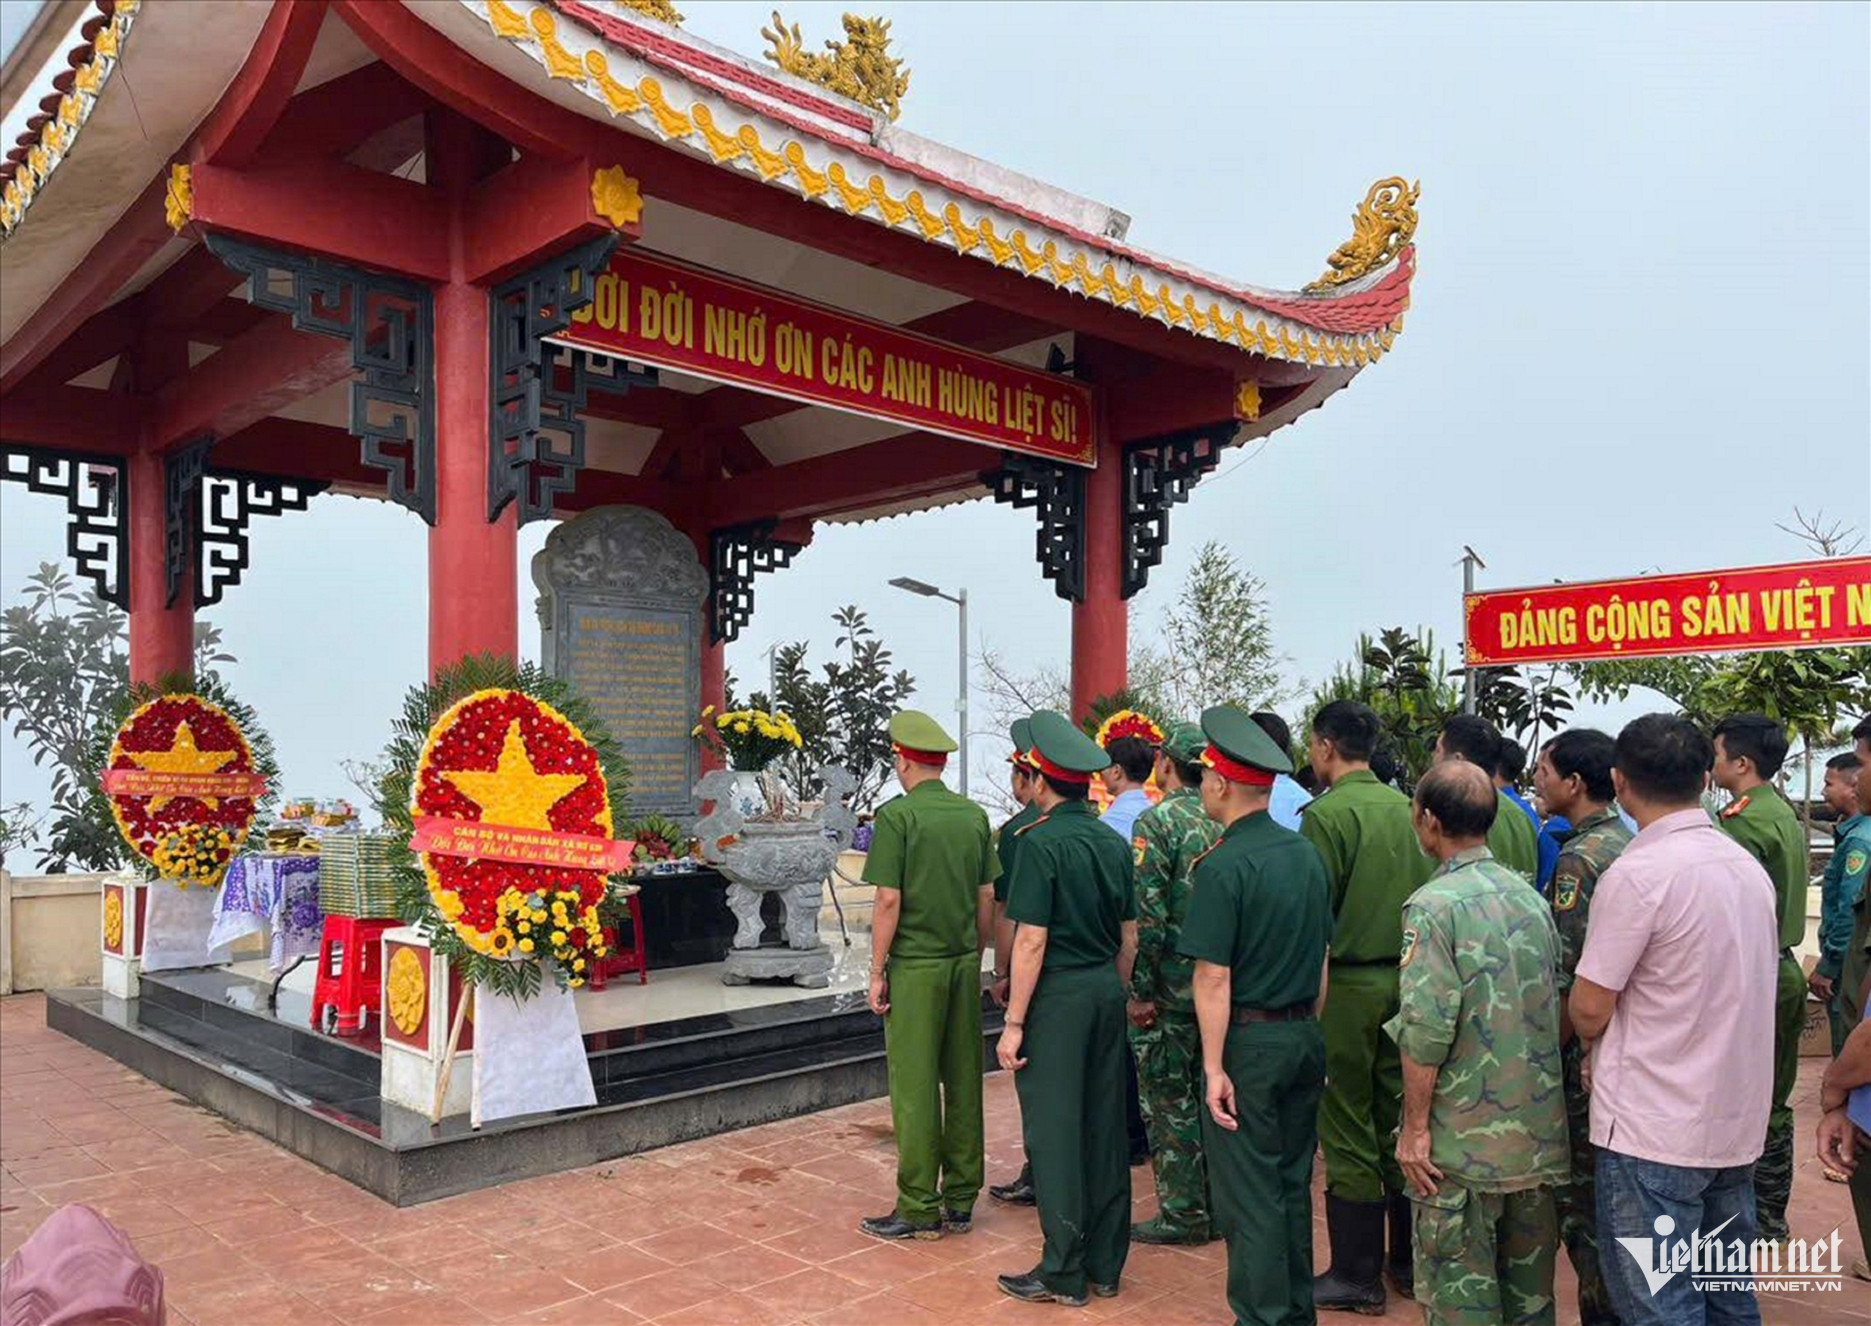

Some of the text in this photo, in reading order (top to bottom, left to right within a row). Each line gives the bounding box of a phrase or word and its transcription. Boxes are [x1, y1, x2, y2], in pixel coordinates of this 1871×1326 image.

[640, 280, 693, 349] ĐỜI
[704, 303, 766, 367] NHỚ
[775, 321, 813, 379] ƠN
[822, 333, 874, 394] CÁC
[882, 353, 932, 409] ANH
[938, 364, 998, 425] HÙNG
[1005, 382, 1045, 443] LIỆT
[1500, 598, 1577, 649] ĐẢNG
[1586, 595, 1671, 650] CỘNG
[1681, 580, 1750, 638] SẢN
[1760, 578, 1835, 639] VIỆT
